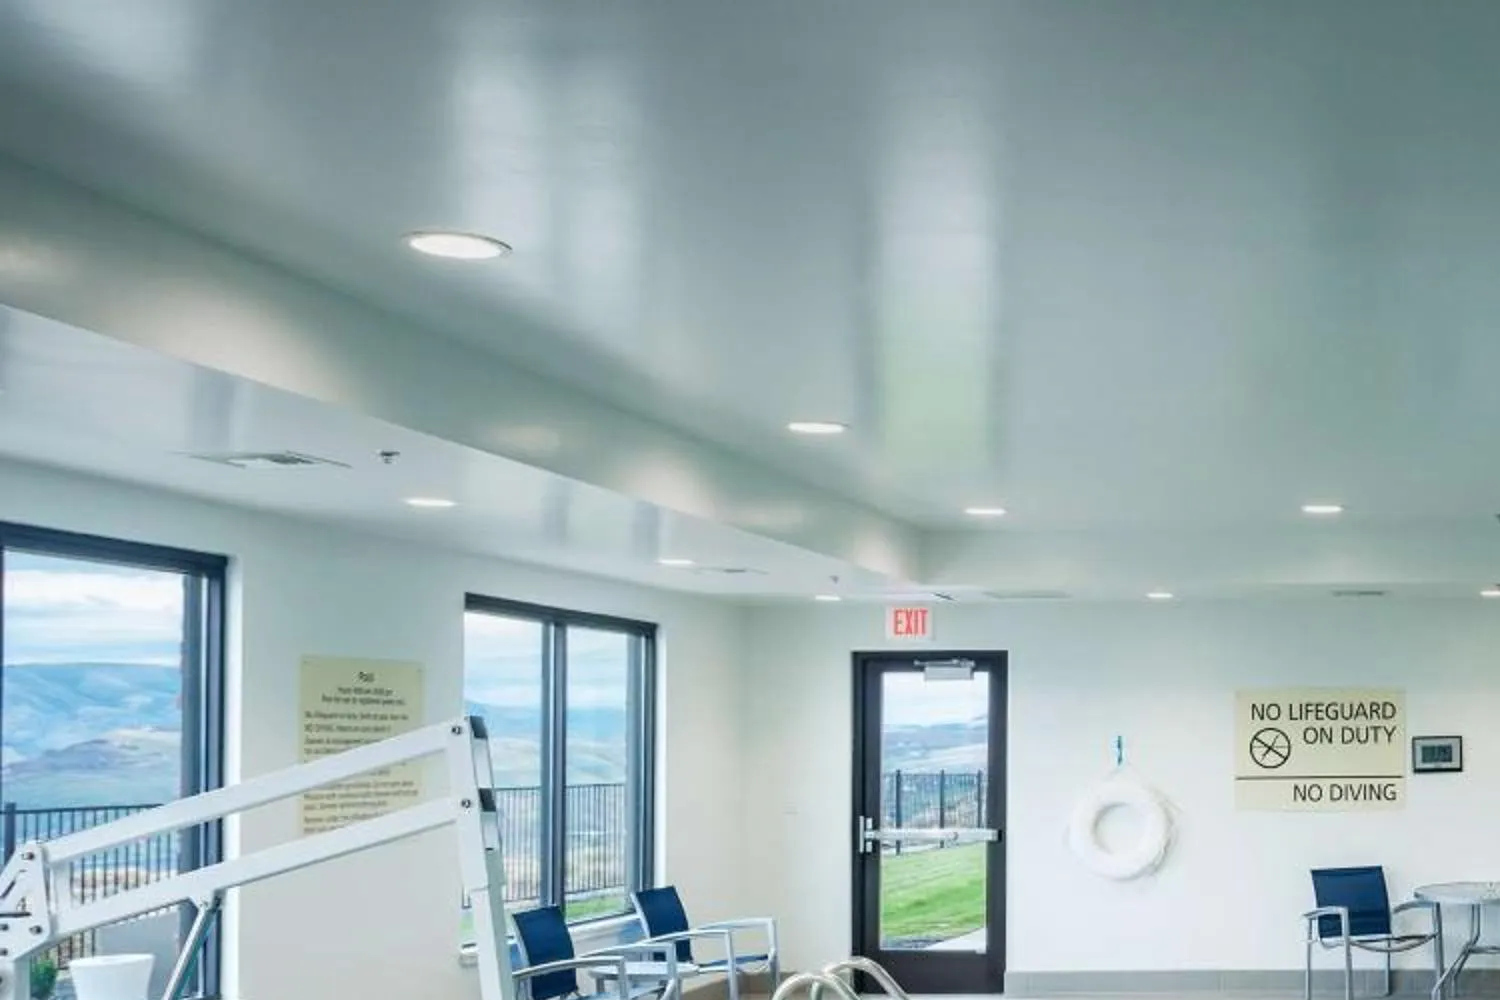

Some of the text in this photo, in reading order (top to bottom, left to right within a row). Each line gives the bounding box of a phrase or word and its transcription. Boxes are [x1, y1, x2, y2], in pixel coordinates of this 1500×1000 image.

[894, 609, 928, 636] EXIT
[1251, 702, 1397, 720] NO LIFEGUARD
[1303, 726, 1397, 744] ON DUTY
[1293, 783, 1397, 801] NO DIVING
